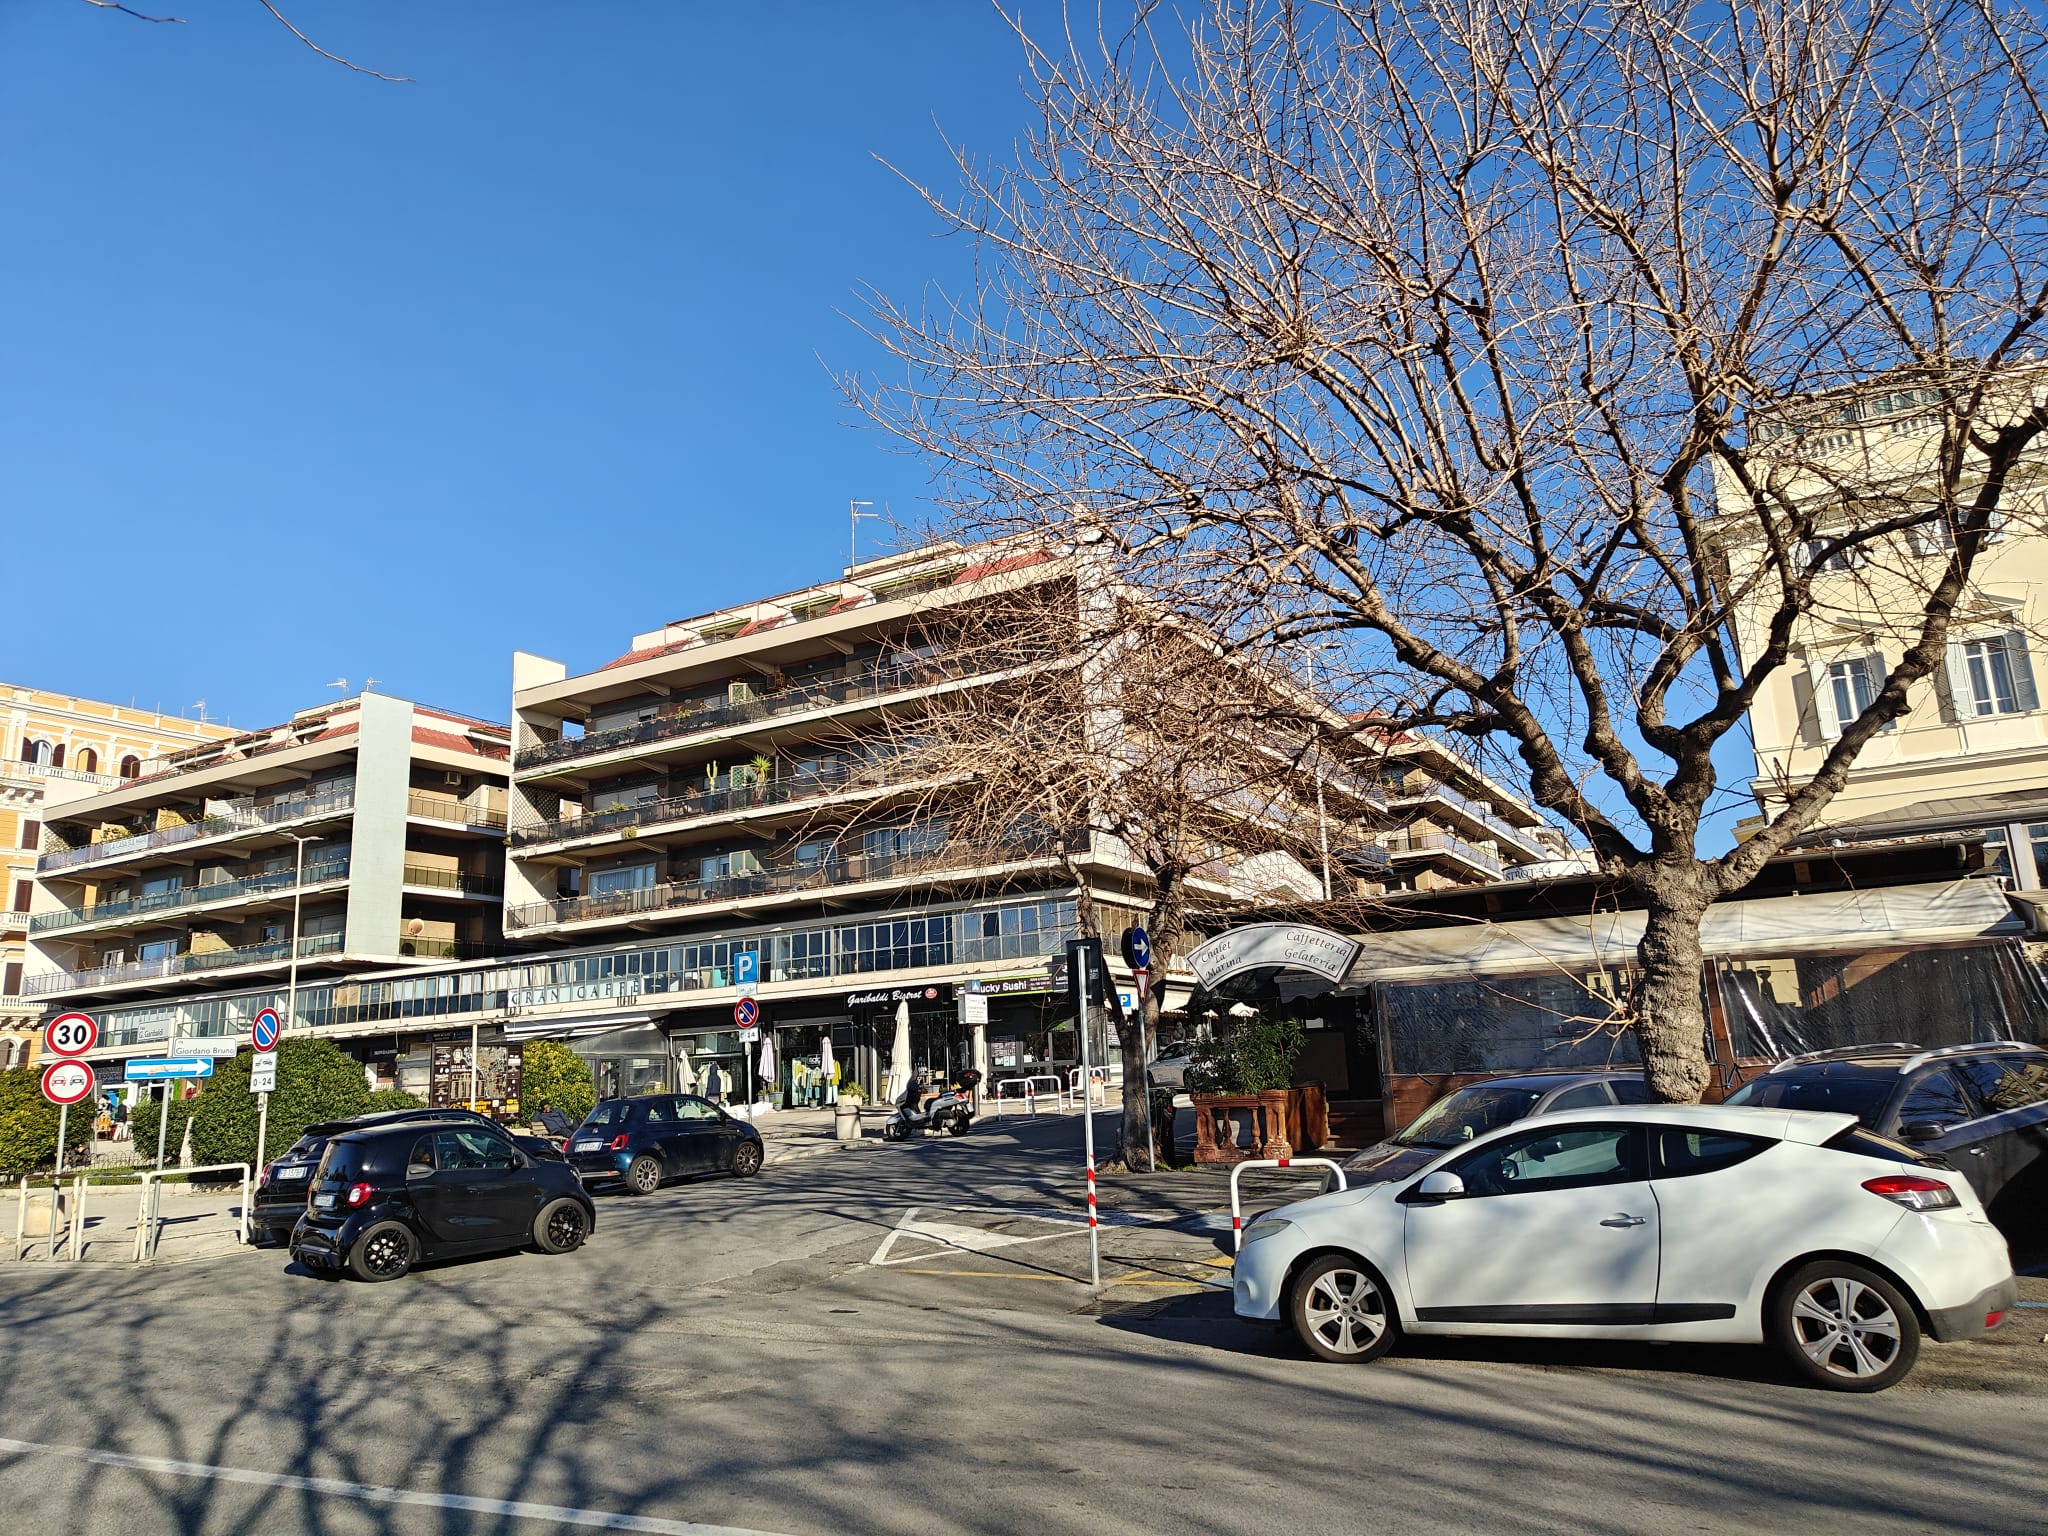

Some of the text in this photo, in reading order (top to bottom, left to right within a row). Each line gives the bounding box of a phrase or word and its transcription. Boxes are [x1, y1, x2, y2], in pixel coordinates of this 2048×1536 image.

[1201, 940, 1232, 963] Chalet
[1286, 931, 1348, 957] Caffetteria
[738, 955, 753, 981] P
[1205, 956, 1242, 981] Marina
[1215, 954, 1225, 963] La
[1284, 949, 1336, 972] Gelateria
[980, 983, 1000, 993] ucky
[1003, 980, 1027, 991] Sushi
[511, 989, 559, 1005] GRAN
[847, 992, 889, 1008] Garibaldi
[892, 989, 923, 1001] Bistrot
[57, 1025, 87, 1045] 30
[175, 1046, 234, 1055] Giordano Bruno
